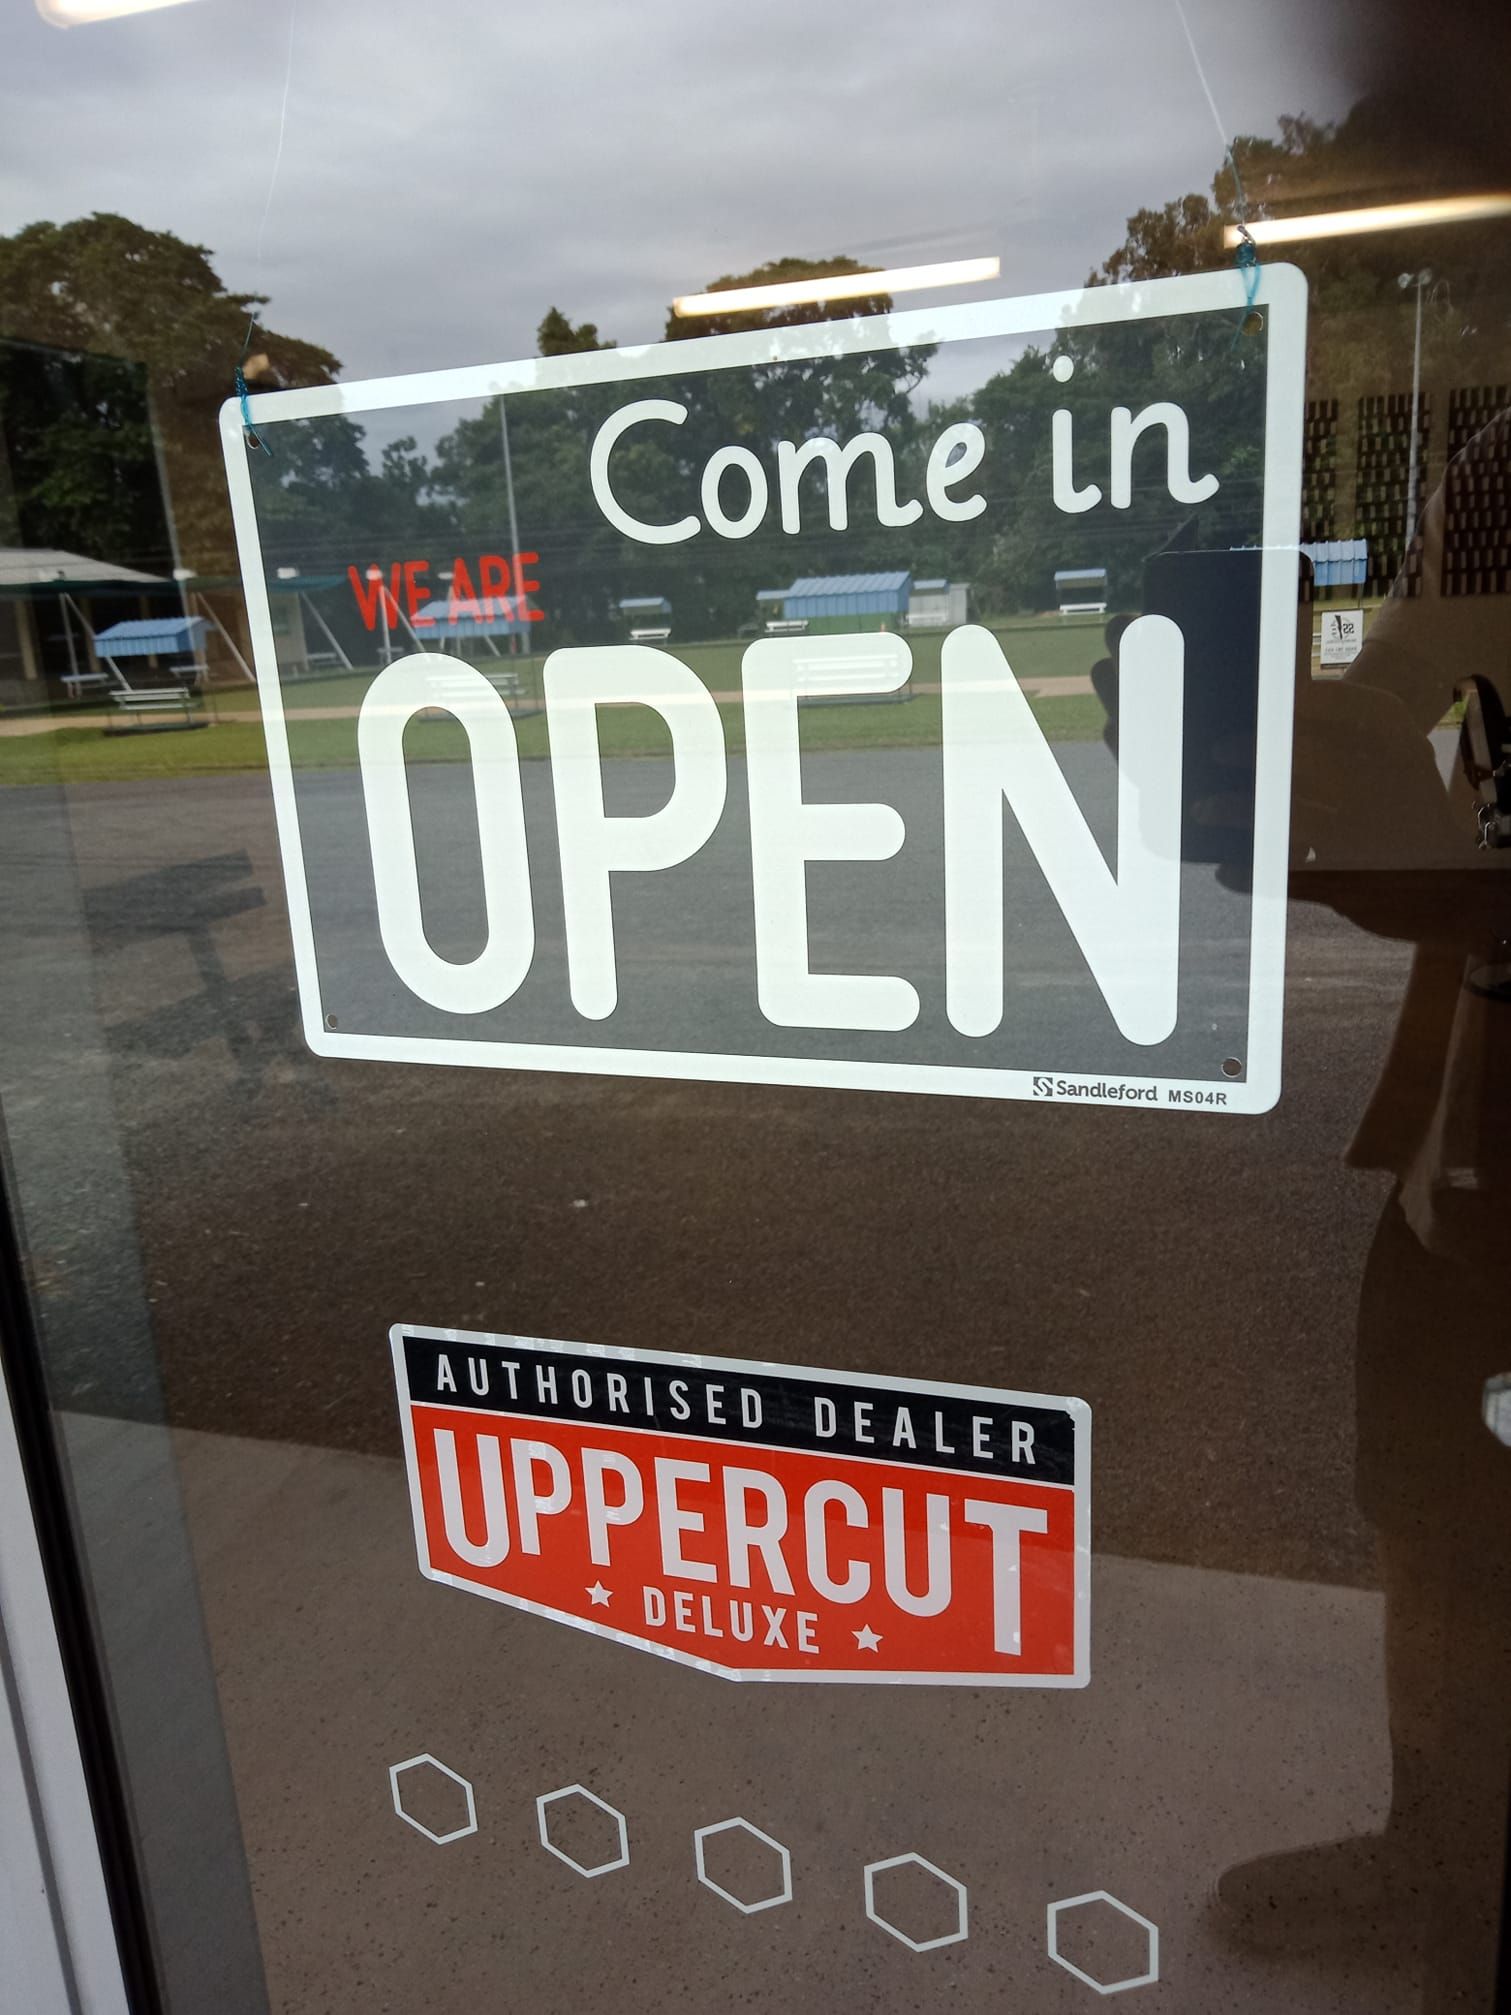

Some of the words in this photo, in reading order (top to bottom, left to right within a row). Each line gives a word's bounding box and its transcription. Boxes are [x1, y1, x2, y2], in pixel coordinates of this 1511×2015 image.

[590, 399, 988, 545] Come
[1052, 355, 1220, 514] in
[347, 561, 437, 631] WE
[447, 551, 545, 625] ARE
[357, 614, 1186, 1047] OPEN
[1056, 1080, 1158, 1102] Sandleford
[1168, 1089, 1228, 1106] MS04R
[437, 1353, 763, 1429] AUTHORISED
[814, 1396, 1036, 1465] DEALER
[433, 1428, 1048, 1656] UPPERCUT
[643, 1585, 820, 1655] DELUXE
